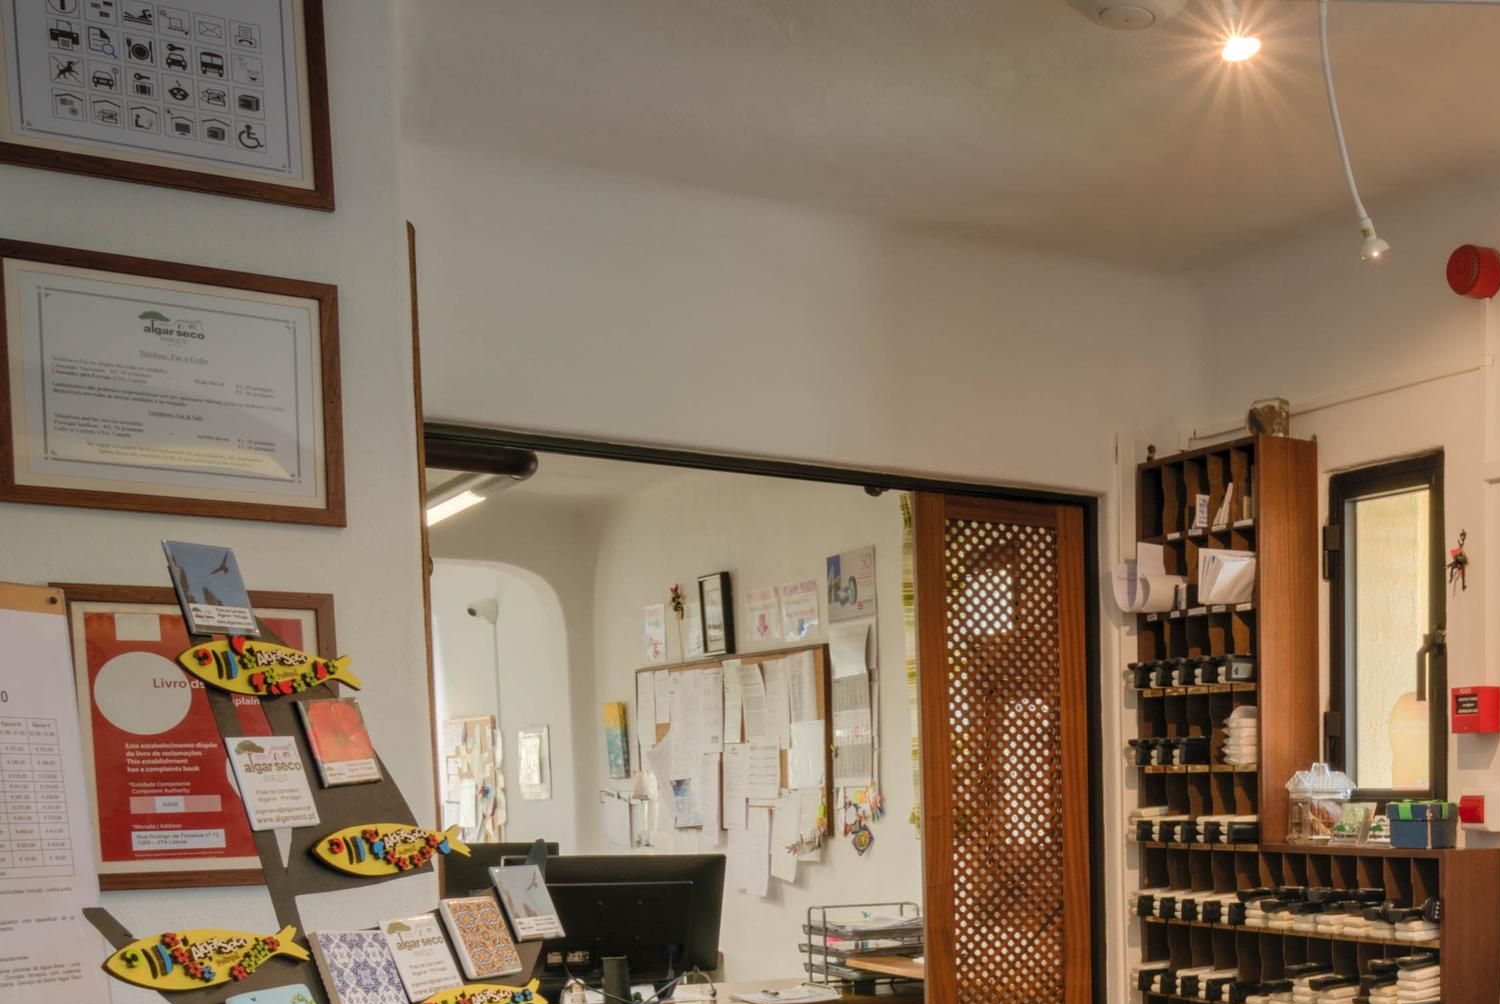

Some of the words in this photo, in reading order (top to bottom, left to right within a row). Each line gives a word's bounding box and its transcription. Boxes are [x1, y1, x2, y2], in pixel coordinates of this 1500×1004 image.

[144, 320, 174, 337] algar
[176, 330, 205, 340] seco
[153, 678, 187, 689] Livro
[140, 742, 195, 750] estabelecimento
[162, 750, 202, 759] reclamações
[244, 757, 274, 775] algar
[274, 761, 301, 772] seco
